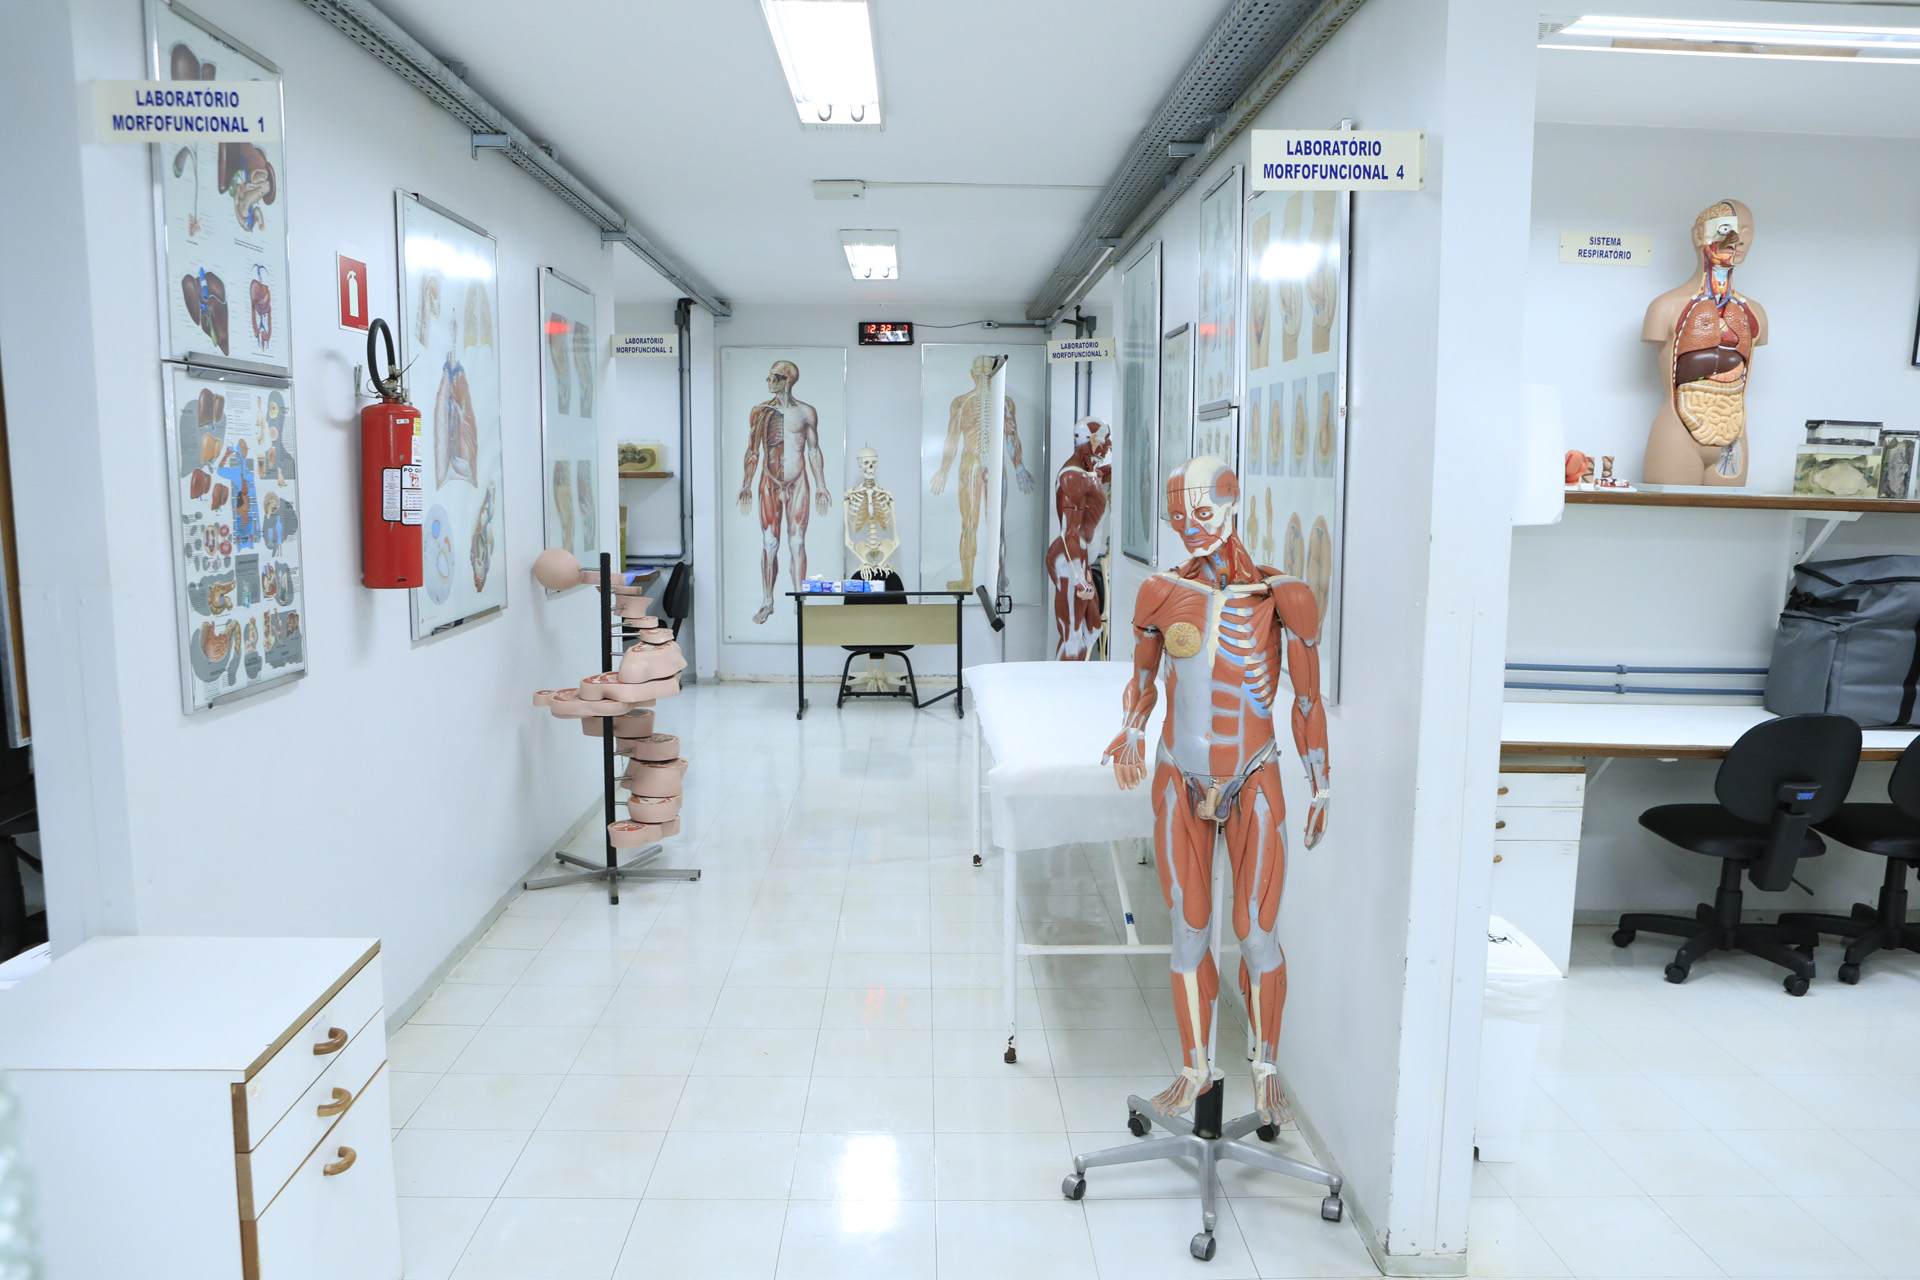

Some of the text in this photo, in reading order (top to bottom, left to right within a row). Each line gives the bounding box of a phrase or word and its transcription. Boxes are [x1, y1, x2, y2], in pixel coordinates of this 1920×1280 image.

[136, 88, 240, 108] LABORATÓRIO
[112, 114, 265, 133] MORFOFUNCIONAL 1
[1286, 137, 1382, 157] LABORATÓRIO
[1263, 163, 1405, 180] MORFOFUNCIONAL 4
[1589, 236, 1622, 247] SISTEMA
[1577, 247, 1632, 260] RESPIRATÓRIO
[616, 346, 673, 354] MORFOFUNCIONAL 2
[1052, 349, 1109, 359] MORFOFUNCIONAL 3
